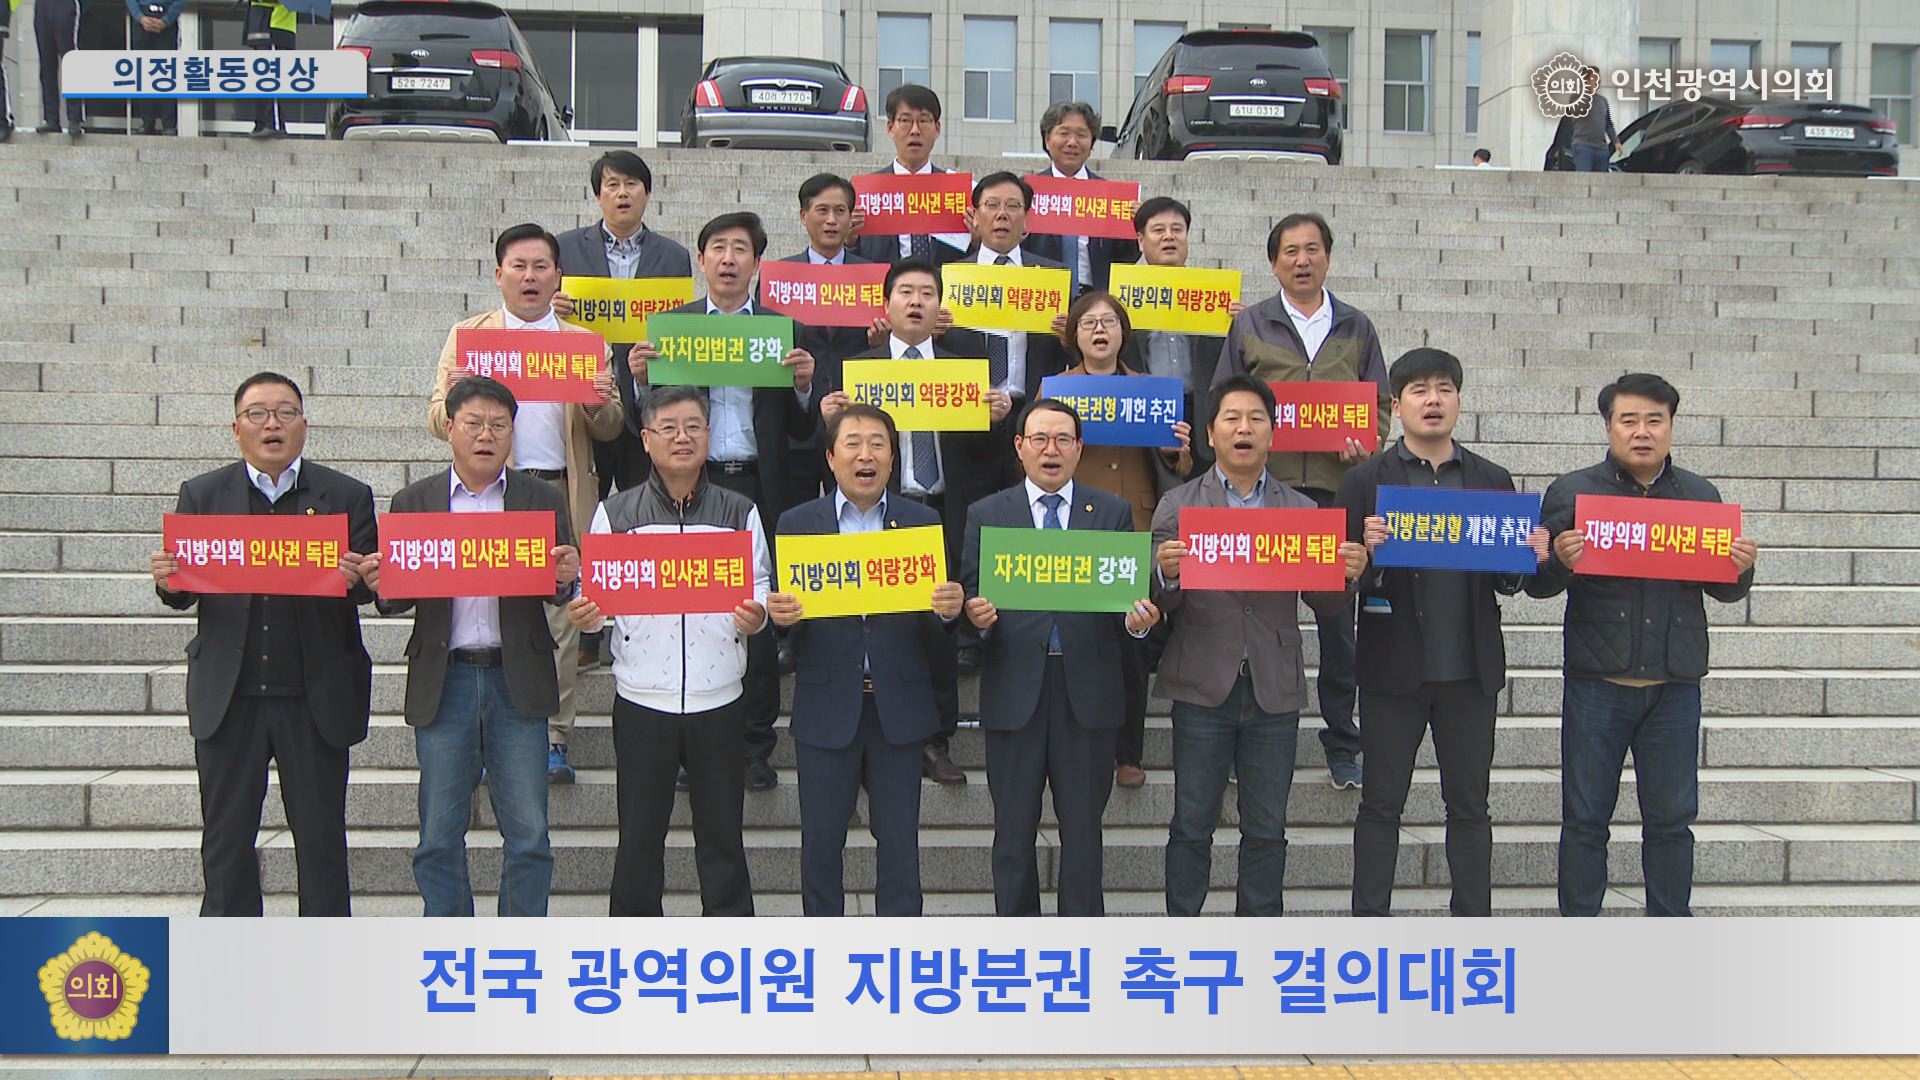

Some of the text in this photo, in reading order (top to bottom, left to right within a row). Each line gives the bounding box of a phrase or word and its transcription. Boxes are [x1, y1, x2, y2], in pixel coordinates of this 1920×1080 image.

[782, 92, 806, 102] 7170
[1256, 106, 1280, 117] 0312
[859, 192, 966, 215] 지방의회 인사권 독립
[1075, 196, 1107, 218] 인사권
[1110, 199, 1133, 220] 독립
[768, 280, 883, 307] 지방의회 인사권 독립
[949, 284, 1062, 313] 지방의회 역량강화
[1119, 284, 1232, 314] 지방의회 역량강화
[571, 298, 626, 323] 지방의회
[659, 336, 783, 364] 자치입법권 강화
[465, 350, 598, 381] 지방의회 인사권 독립
[854, 382, 981, 408] 지방의회 역량강화
[1120, 397, 1146, 423] 개헌
[1149, 398, 1176, 424] 추진
[1299, 403, 1339, 429] 인사권
[1343, 403, 1369, 429] 독립
[1385, 511, 1532, 546] 지방분권형 개헌 추진
[1584, 519, 1732, 556] 지방의회 인사권 독립
[175, 538, 339, 568] 지방의회 인사권 독립
[389, 537, 546, 570] 지방의회 인사권 독립
[1188, 532, 1337, 564] 지방의회 인사권 독립
[591, 556, 745, 591] 지방의회 인사권 독립
[790, 554, 937, 592] 지방의회 역량강화
[993, 553, 1138, 585] 자치입법권 강화
